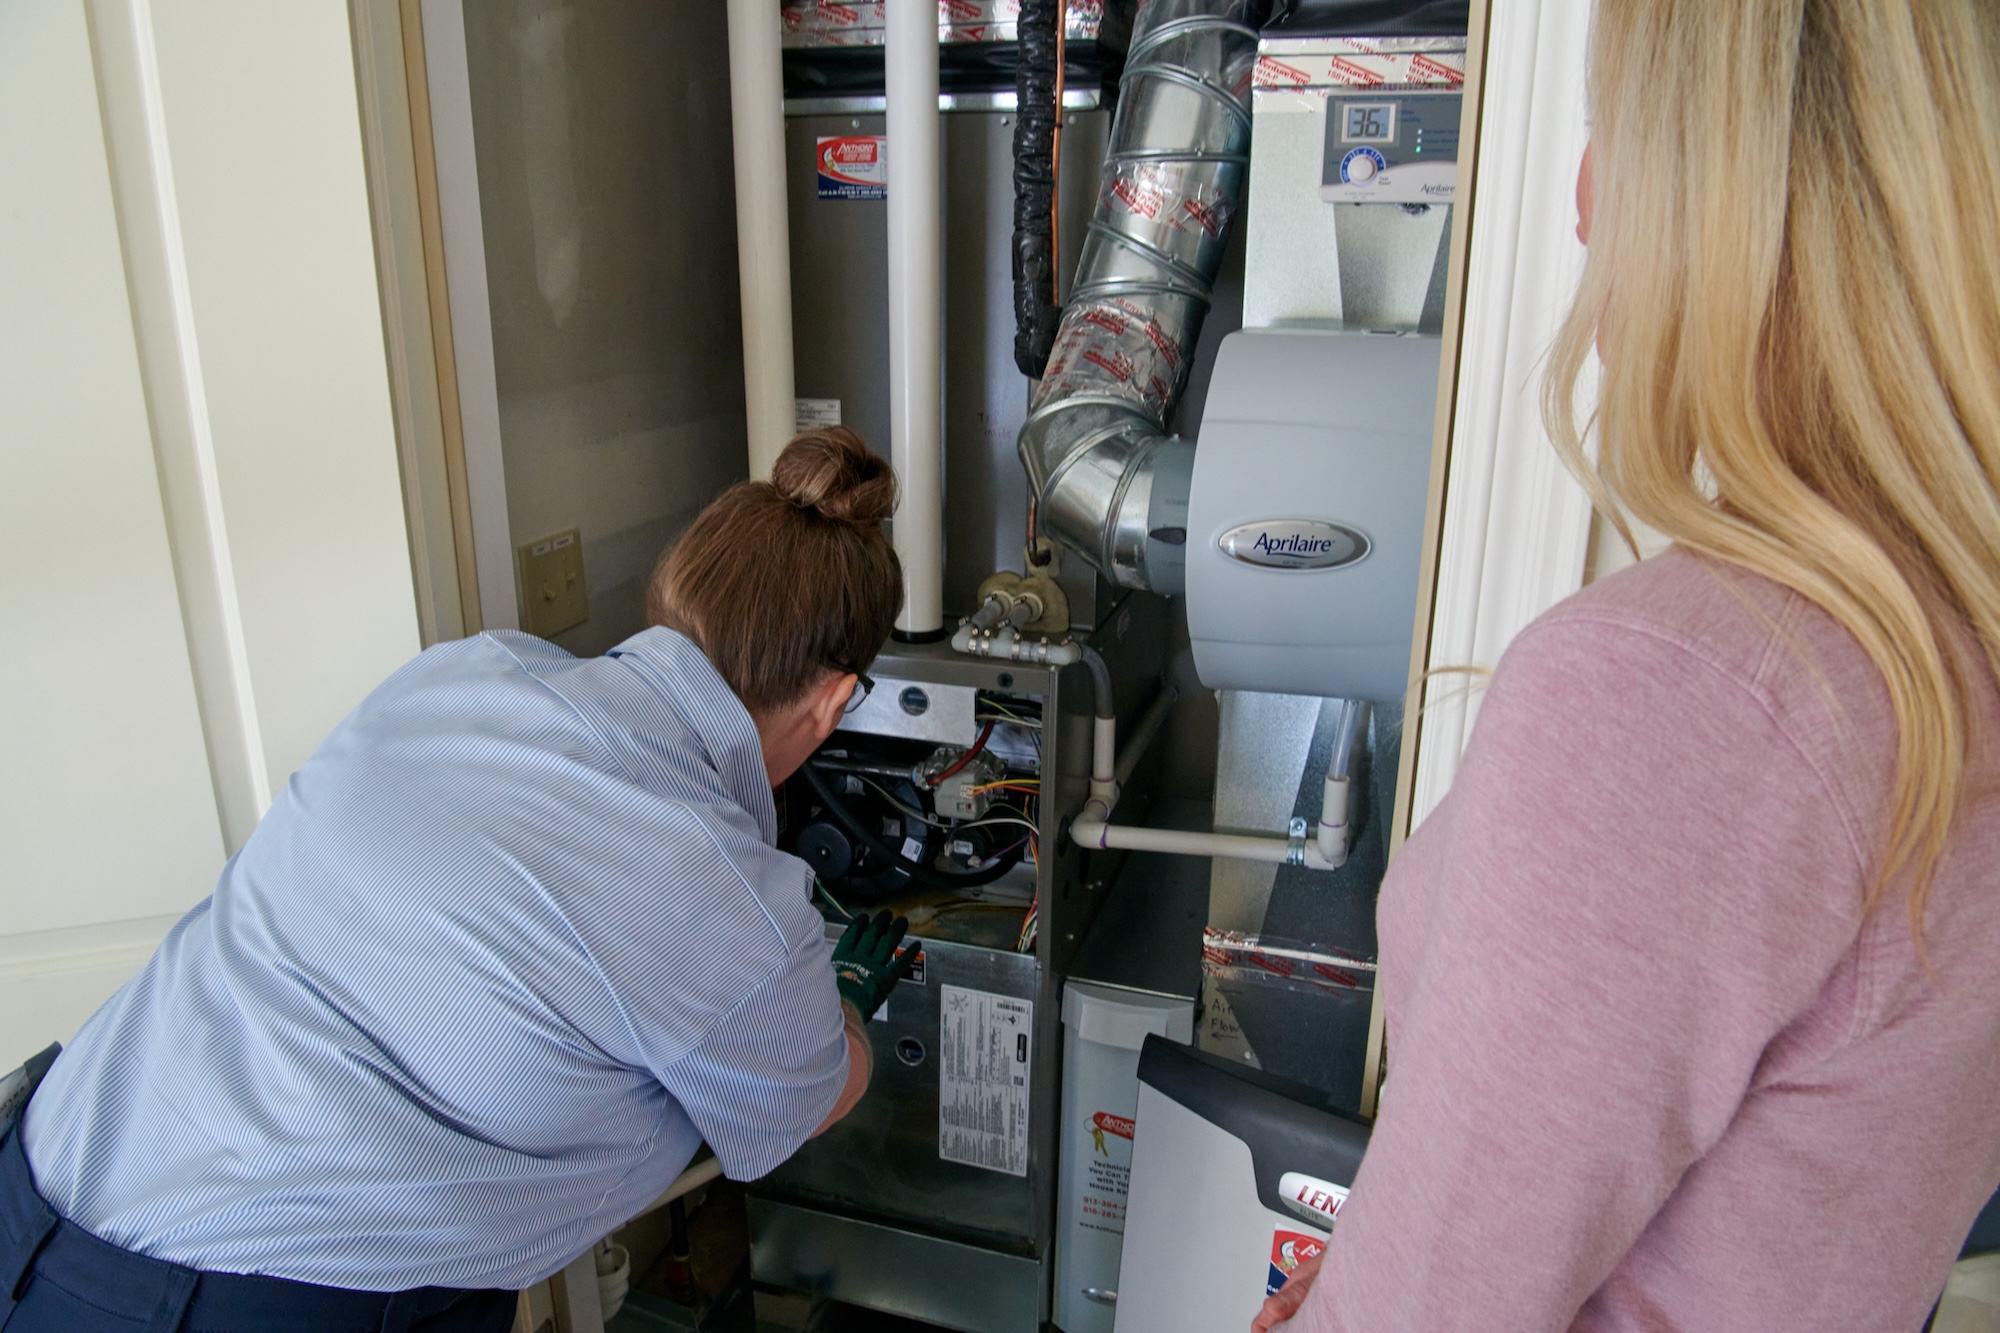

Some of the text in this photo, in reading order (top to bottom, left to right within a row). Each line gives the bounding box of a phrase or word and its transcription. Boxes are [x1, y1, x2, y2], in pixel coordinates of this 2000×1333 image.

[1350, 108, 1381, 137] 36
[1420, 183, 1455, 196] Aprilaire
[1253, 532, 1332, 556] Aprilaire
[1212, 998, 1234, 1014] Air
[1211, 1017, 1240, 1033] Flow
[1106, 1170, 1121, 1178] Can
[1089, 1182, 1114, 1192] House
[1297, 1184, 1340, 1217] LEN
